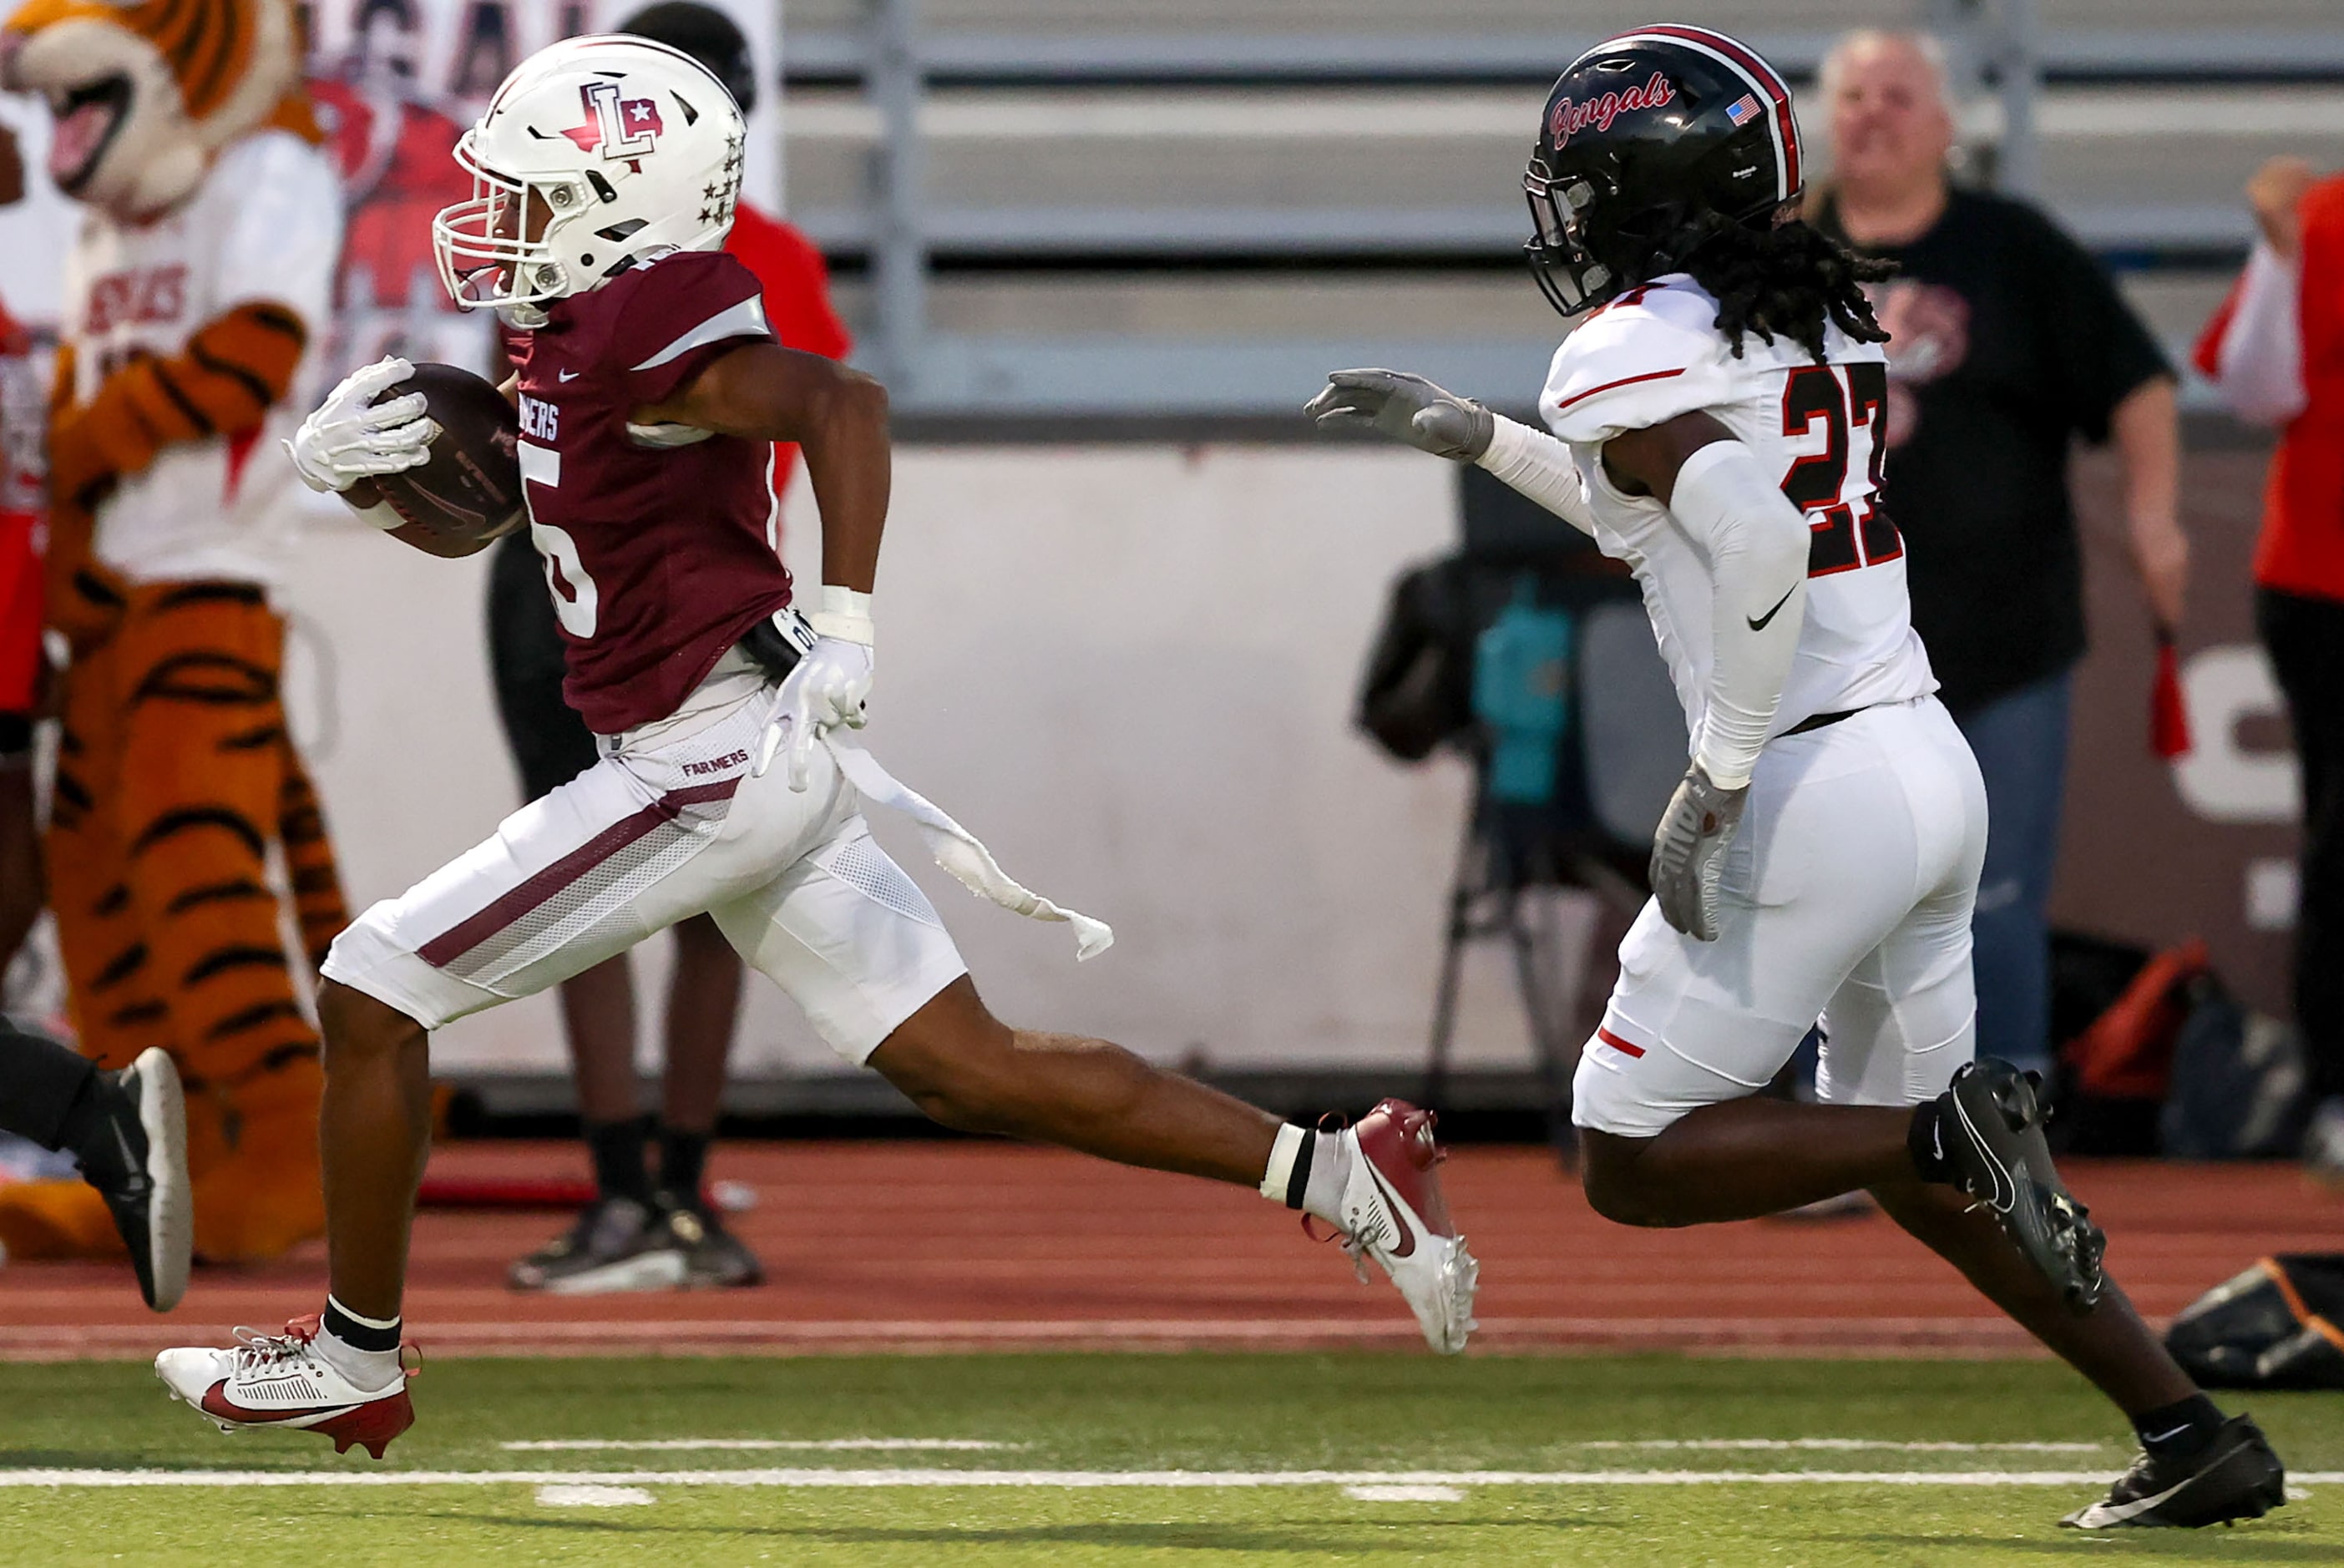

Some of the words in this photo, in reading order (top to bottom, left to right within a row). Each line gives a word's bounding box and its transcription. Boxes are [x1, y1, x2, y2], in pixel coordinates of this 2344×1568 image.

[1549, 71, 1676, 150] Bengals
[518, 392, 559, 441] MERS
[1780, 362, 1904, 578] 27
[682, 749, 748, 777] FARMERS
